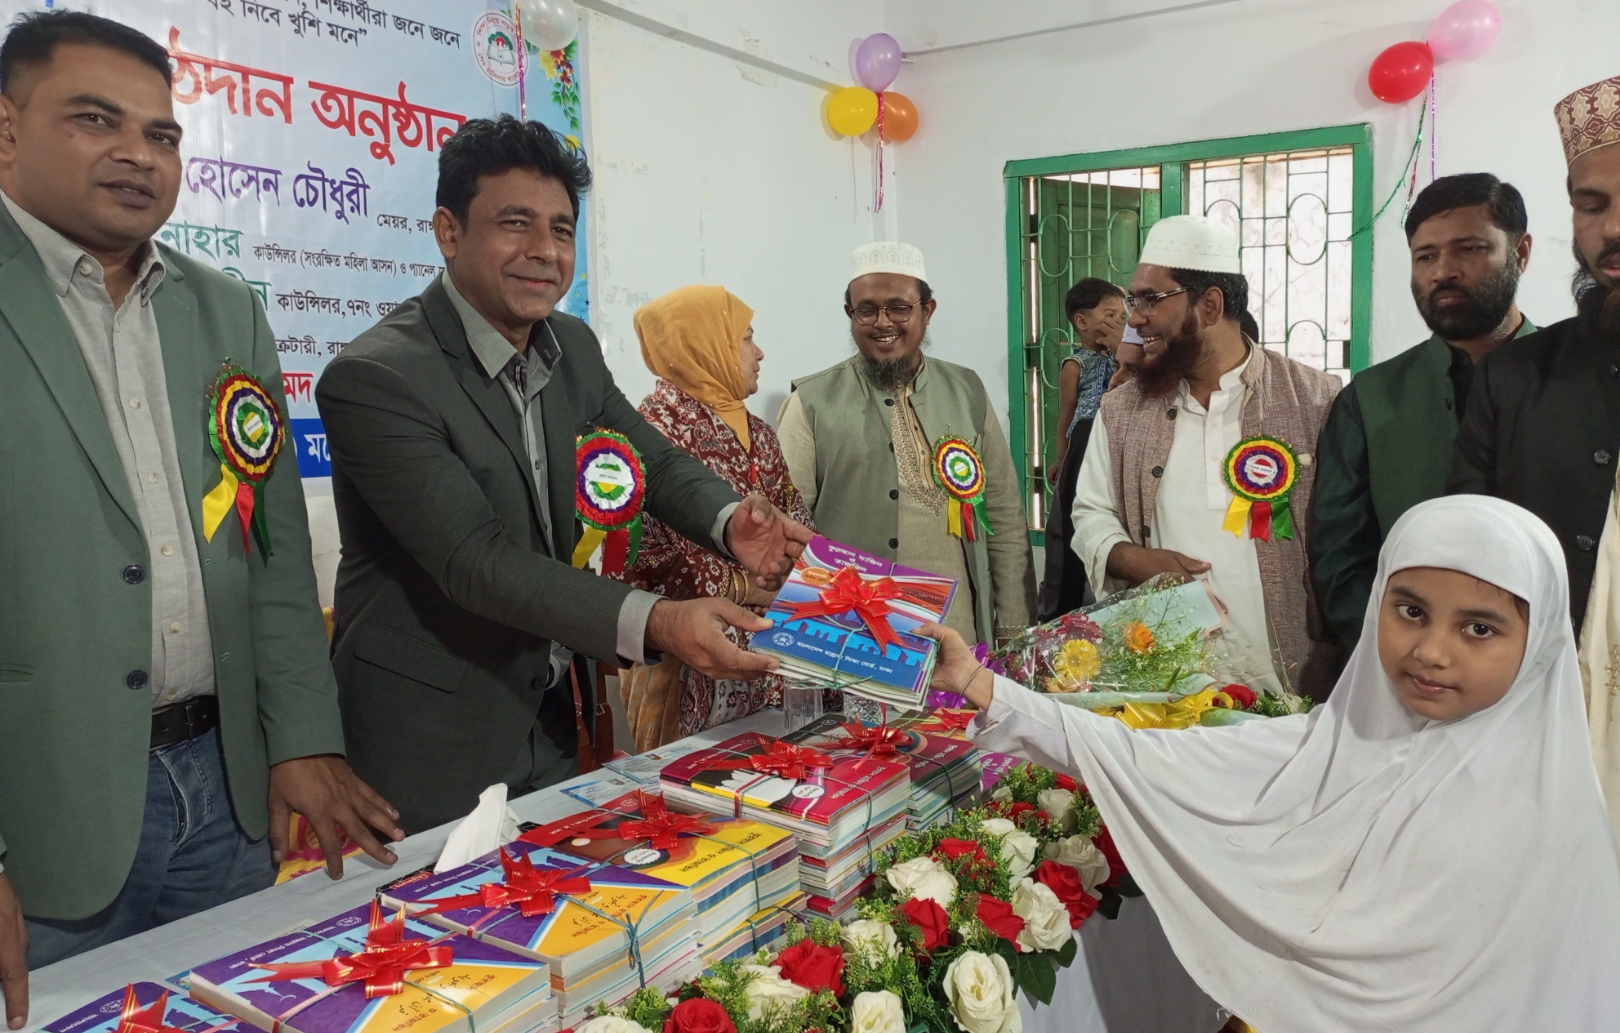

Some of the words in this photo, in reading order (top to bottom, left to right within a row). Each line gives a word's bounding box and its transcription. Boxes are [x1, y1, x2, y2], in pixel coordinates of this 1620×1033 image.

[289, 10, 321, 38] খুশি
[393, 14, 424, 39] জনে
[429, 25, 461, 49] জনে
[166, 25, 294, 125] ঠদান
[186, 155, 283, 208] হোসেন
[293, 160, 371, 226] চৌধুরী
[252, 242, 297, 265] কাউন্সিলর
[343, 252, 368, 272] মহিলা
[370, 258, 397, 278] আসন)
